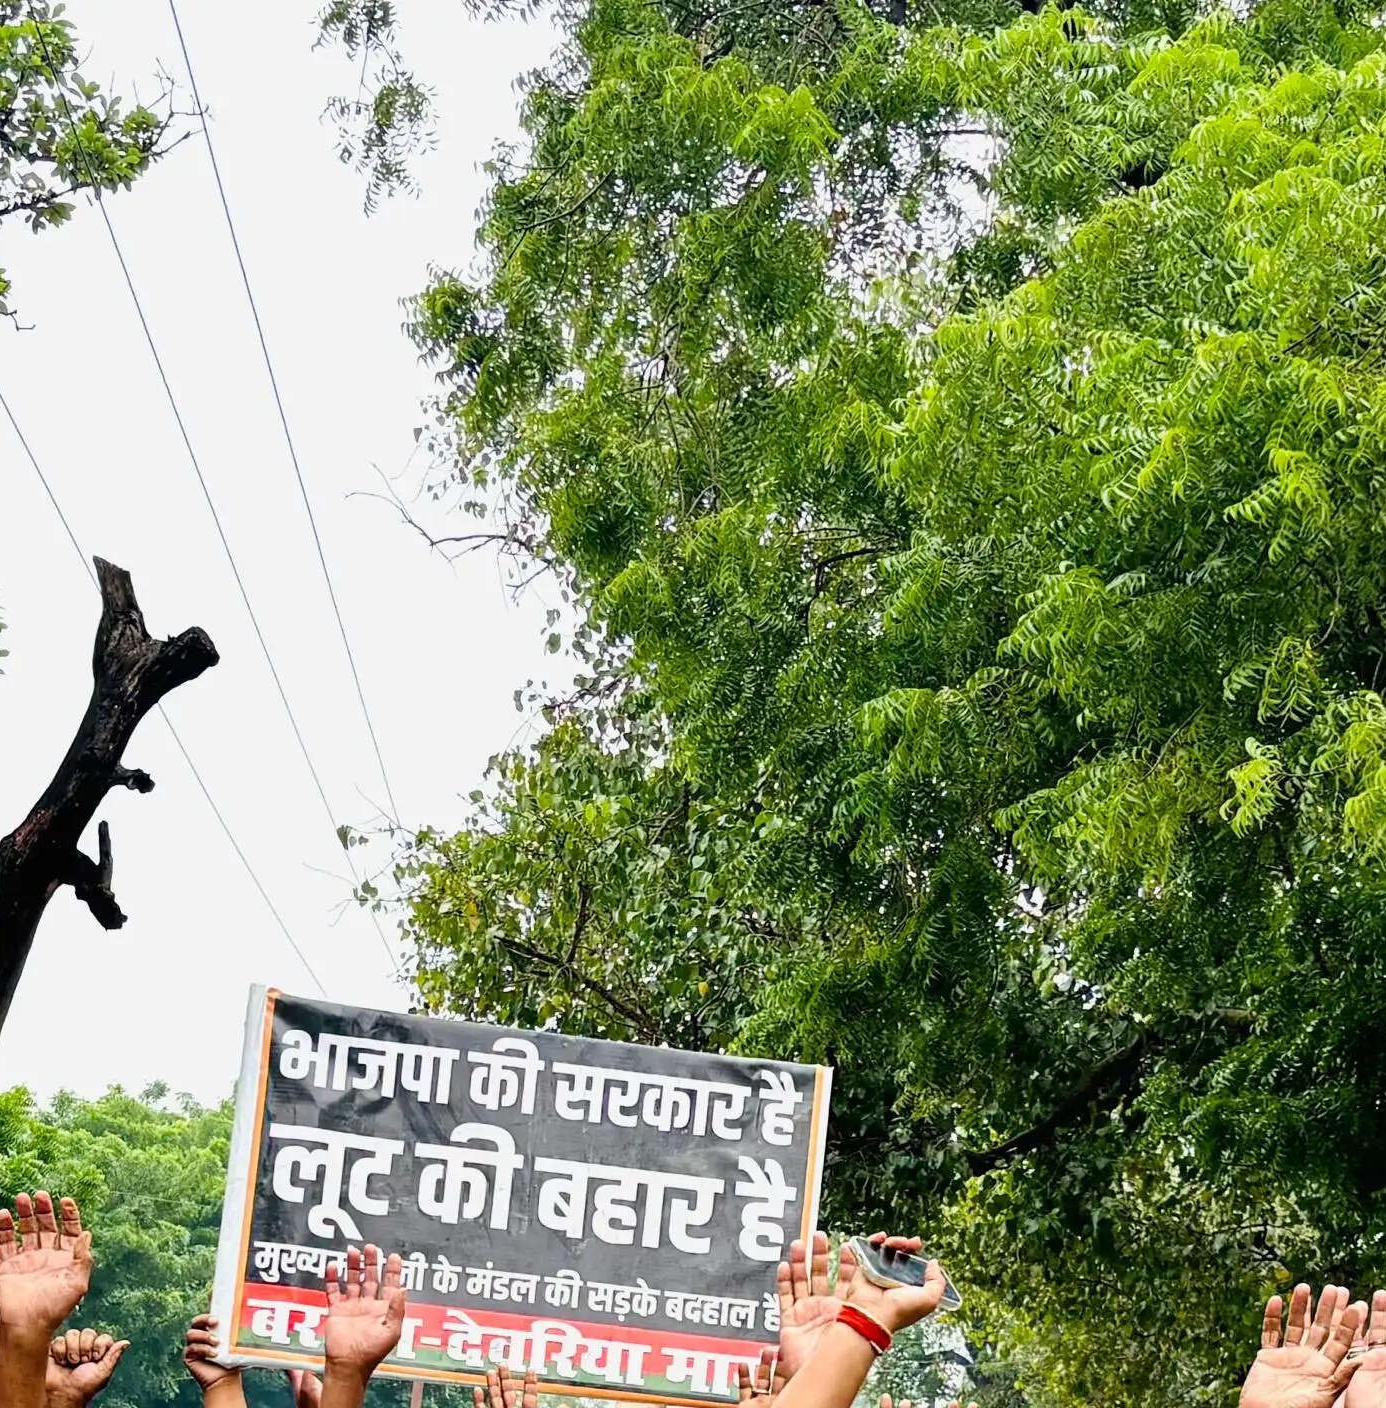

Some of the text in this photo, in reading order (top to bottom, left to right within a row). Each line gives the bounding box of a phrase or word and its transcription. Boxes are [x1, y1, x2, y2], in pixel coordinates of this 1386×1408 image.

[278, 1028, 804, 1146] भाजपा की सरकार है
[269, 1122, 798, 1262] लूट की बहार है
[431, 1254, 463, 1294] के
[465, 1261, 541, 1304] मंडल
[543, 1268, 584, 1309] की
[586, 1277, 662, 1323] सड़के
[663, 1290, 760, 1330] बदहाल
